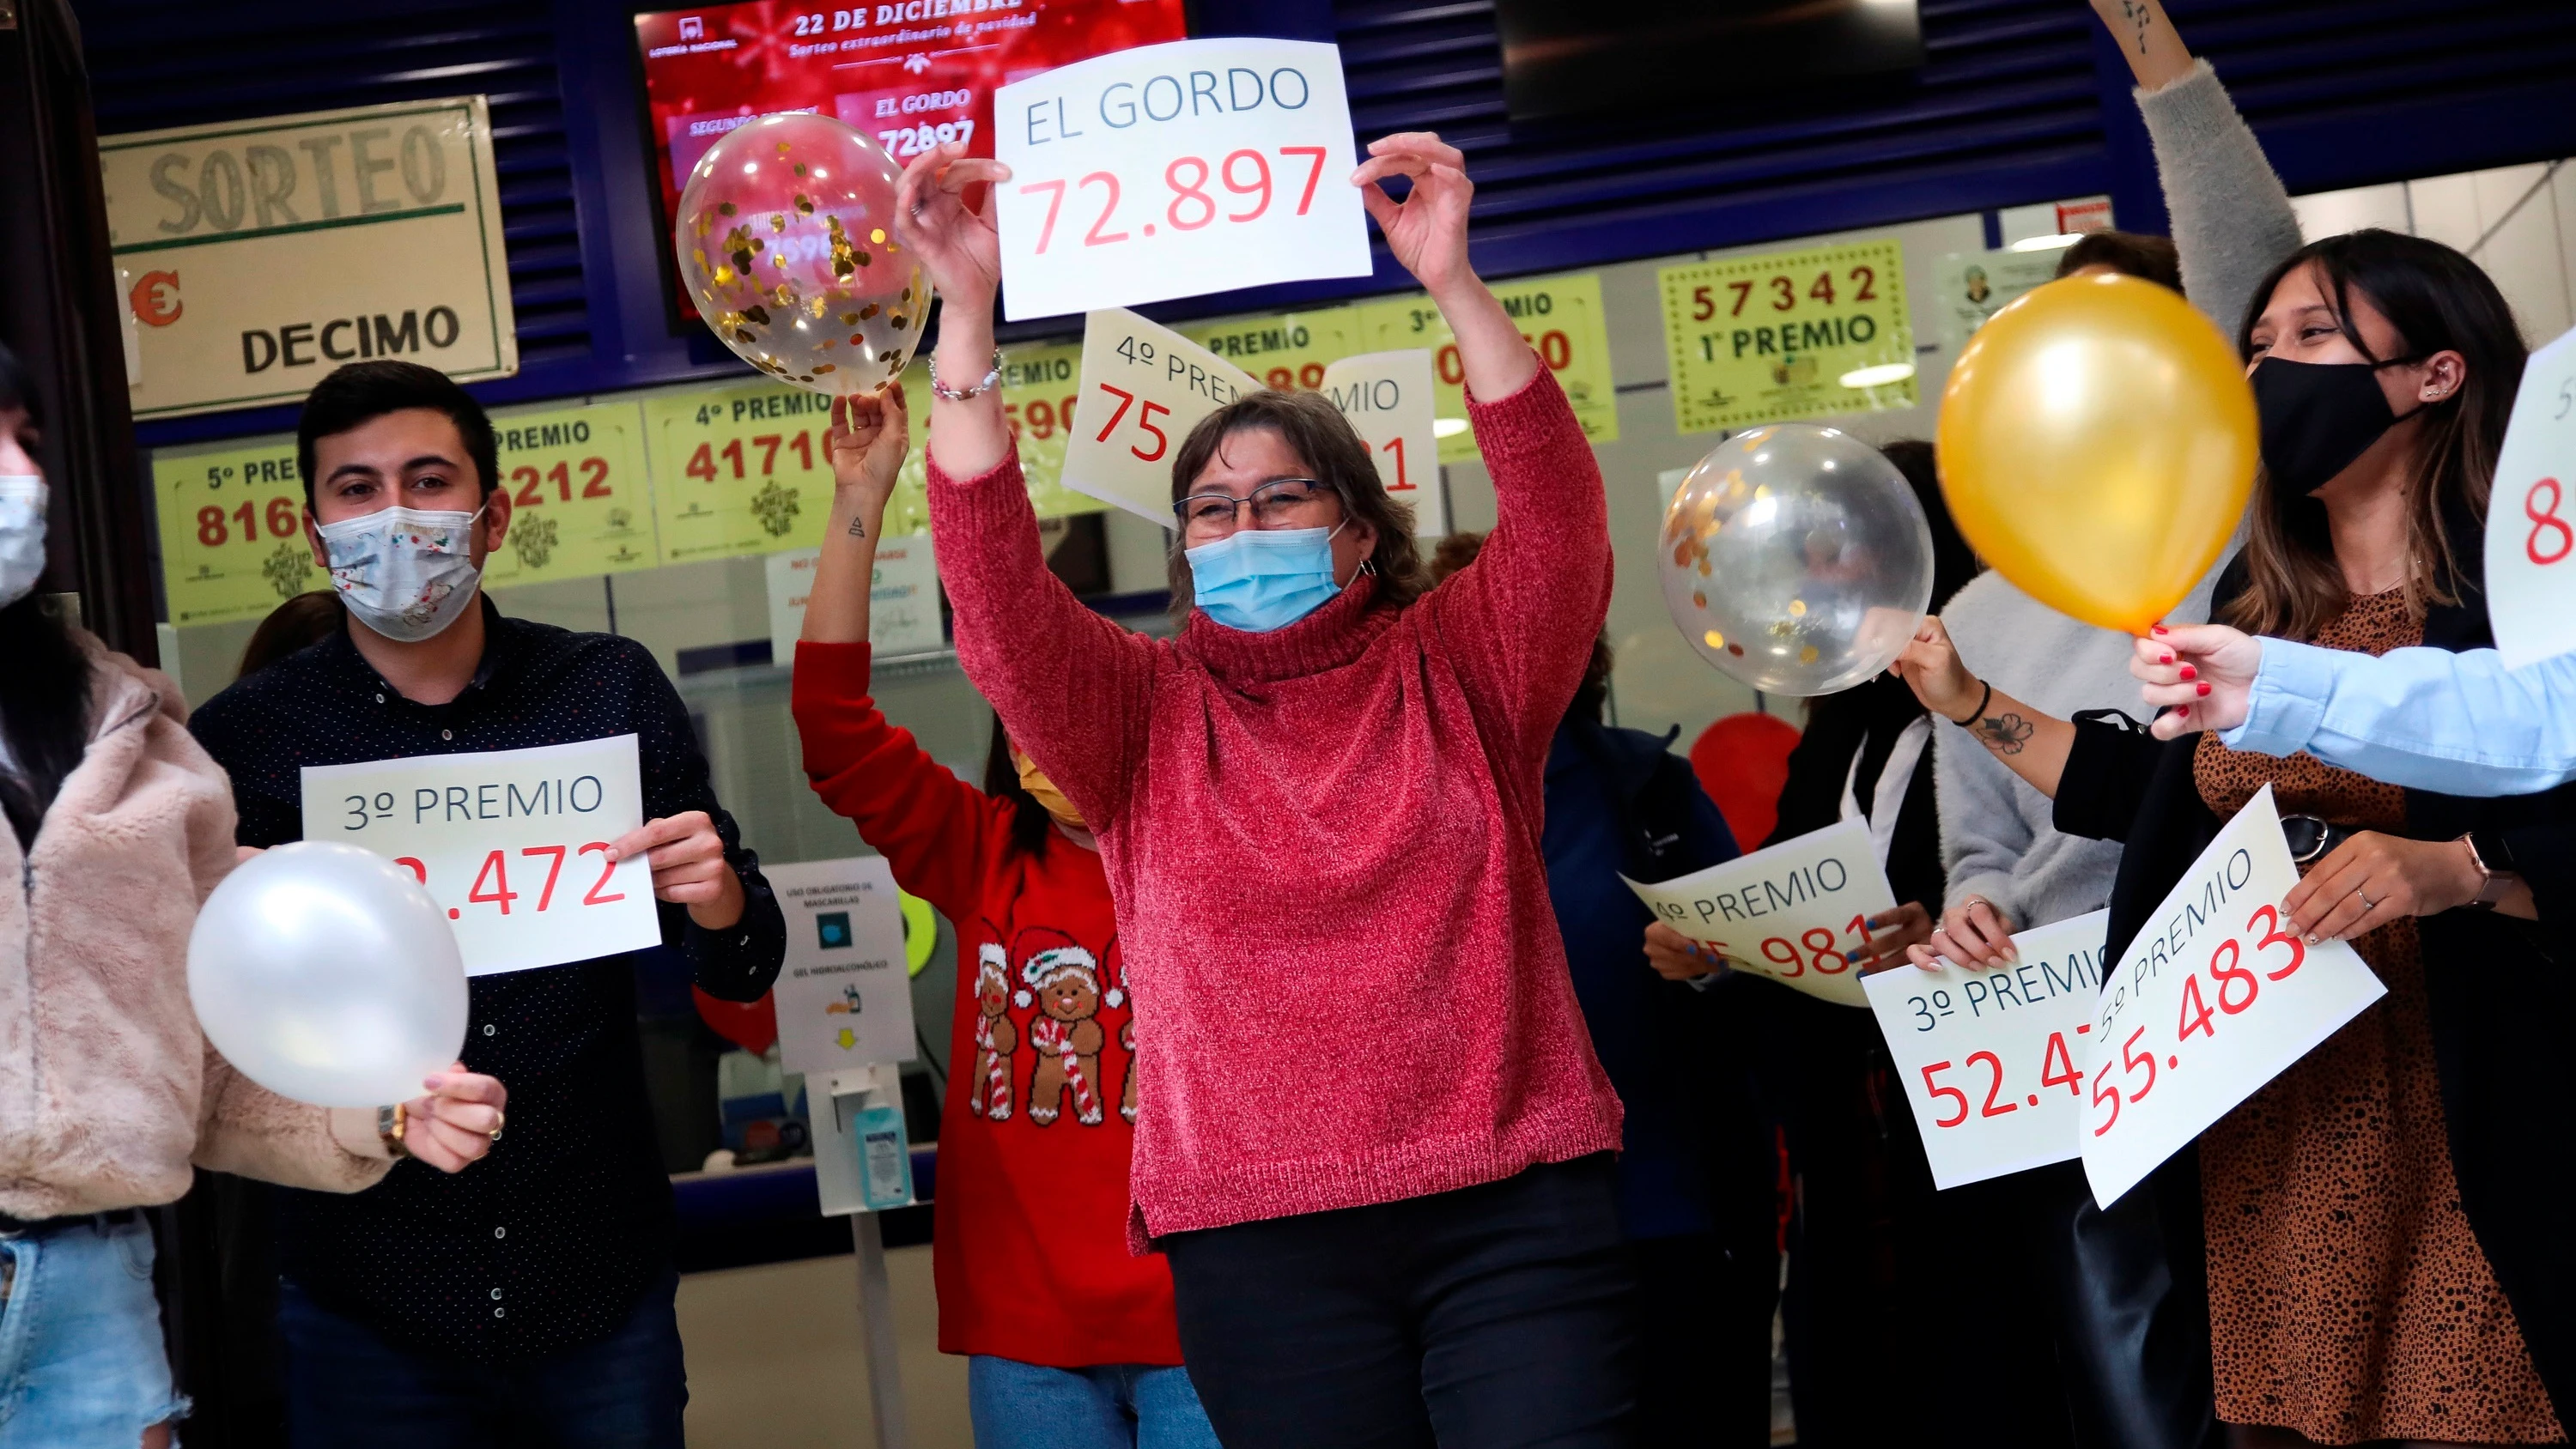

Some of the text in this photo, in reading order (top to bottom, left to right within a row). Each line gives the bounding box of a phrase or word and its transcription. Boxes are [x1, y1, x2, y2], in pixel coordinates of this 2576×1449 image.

[789, 42, 838, 58] Sorteo
[841, 27, 951, 49] extraordinario
[954, 21, 973, 35] de
[795, 14, 824, 36] 22
[833, 8, 867, 31] DE
[875, 88, 971, 118] EL GORDO
[1027, 67, 1309, 146] EL GORDO
[878, 119, 975, 157] 72897
[149, 124, 447, 234] SORTEO
[1019, 146, 1327, 256] 72.897
[241, 306, 459, 375] DECIMO
[1209, 324, 1310, 355] PREMIO
[1733, 313, 1877, 359] PREMIO
[732, 391, 831, 422] PREMIO
[414, 774, 603, 824] PREMIO
[804, 896, 859, 908] MASCARILLAS
[1694, 858, 1848, 925] PREMIO
[2134, 847, 2251, 997] PREMIO
[793, 967, 809, 979] GEL
[2093, 904, 2306, 1137] 55.483
